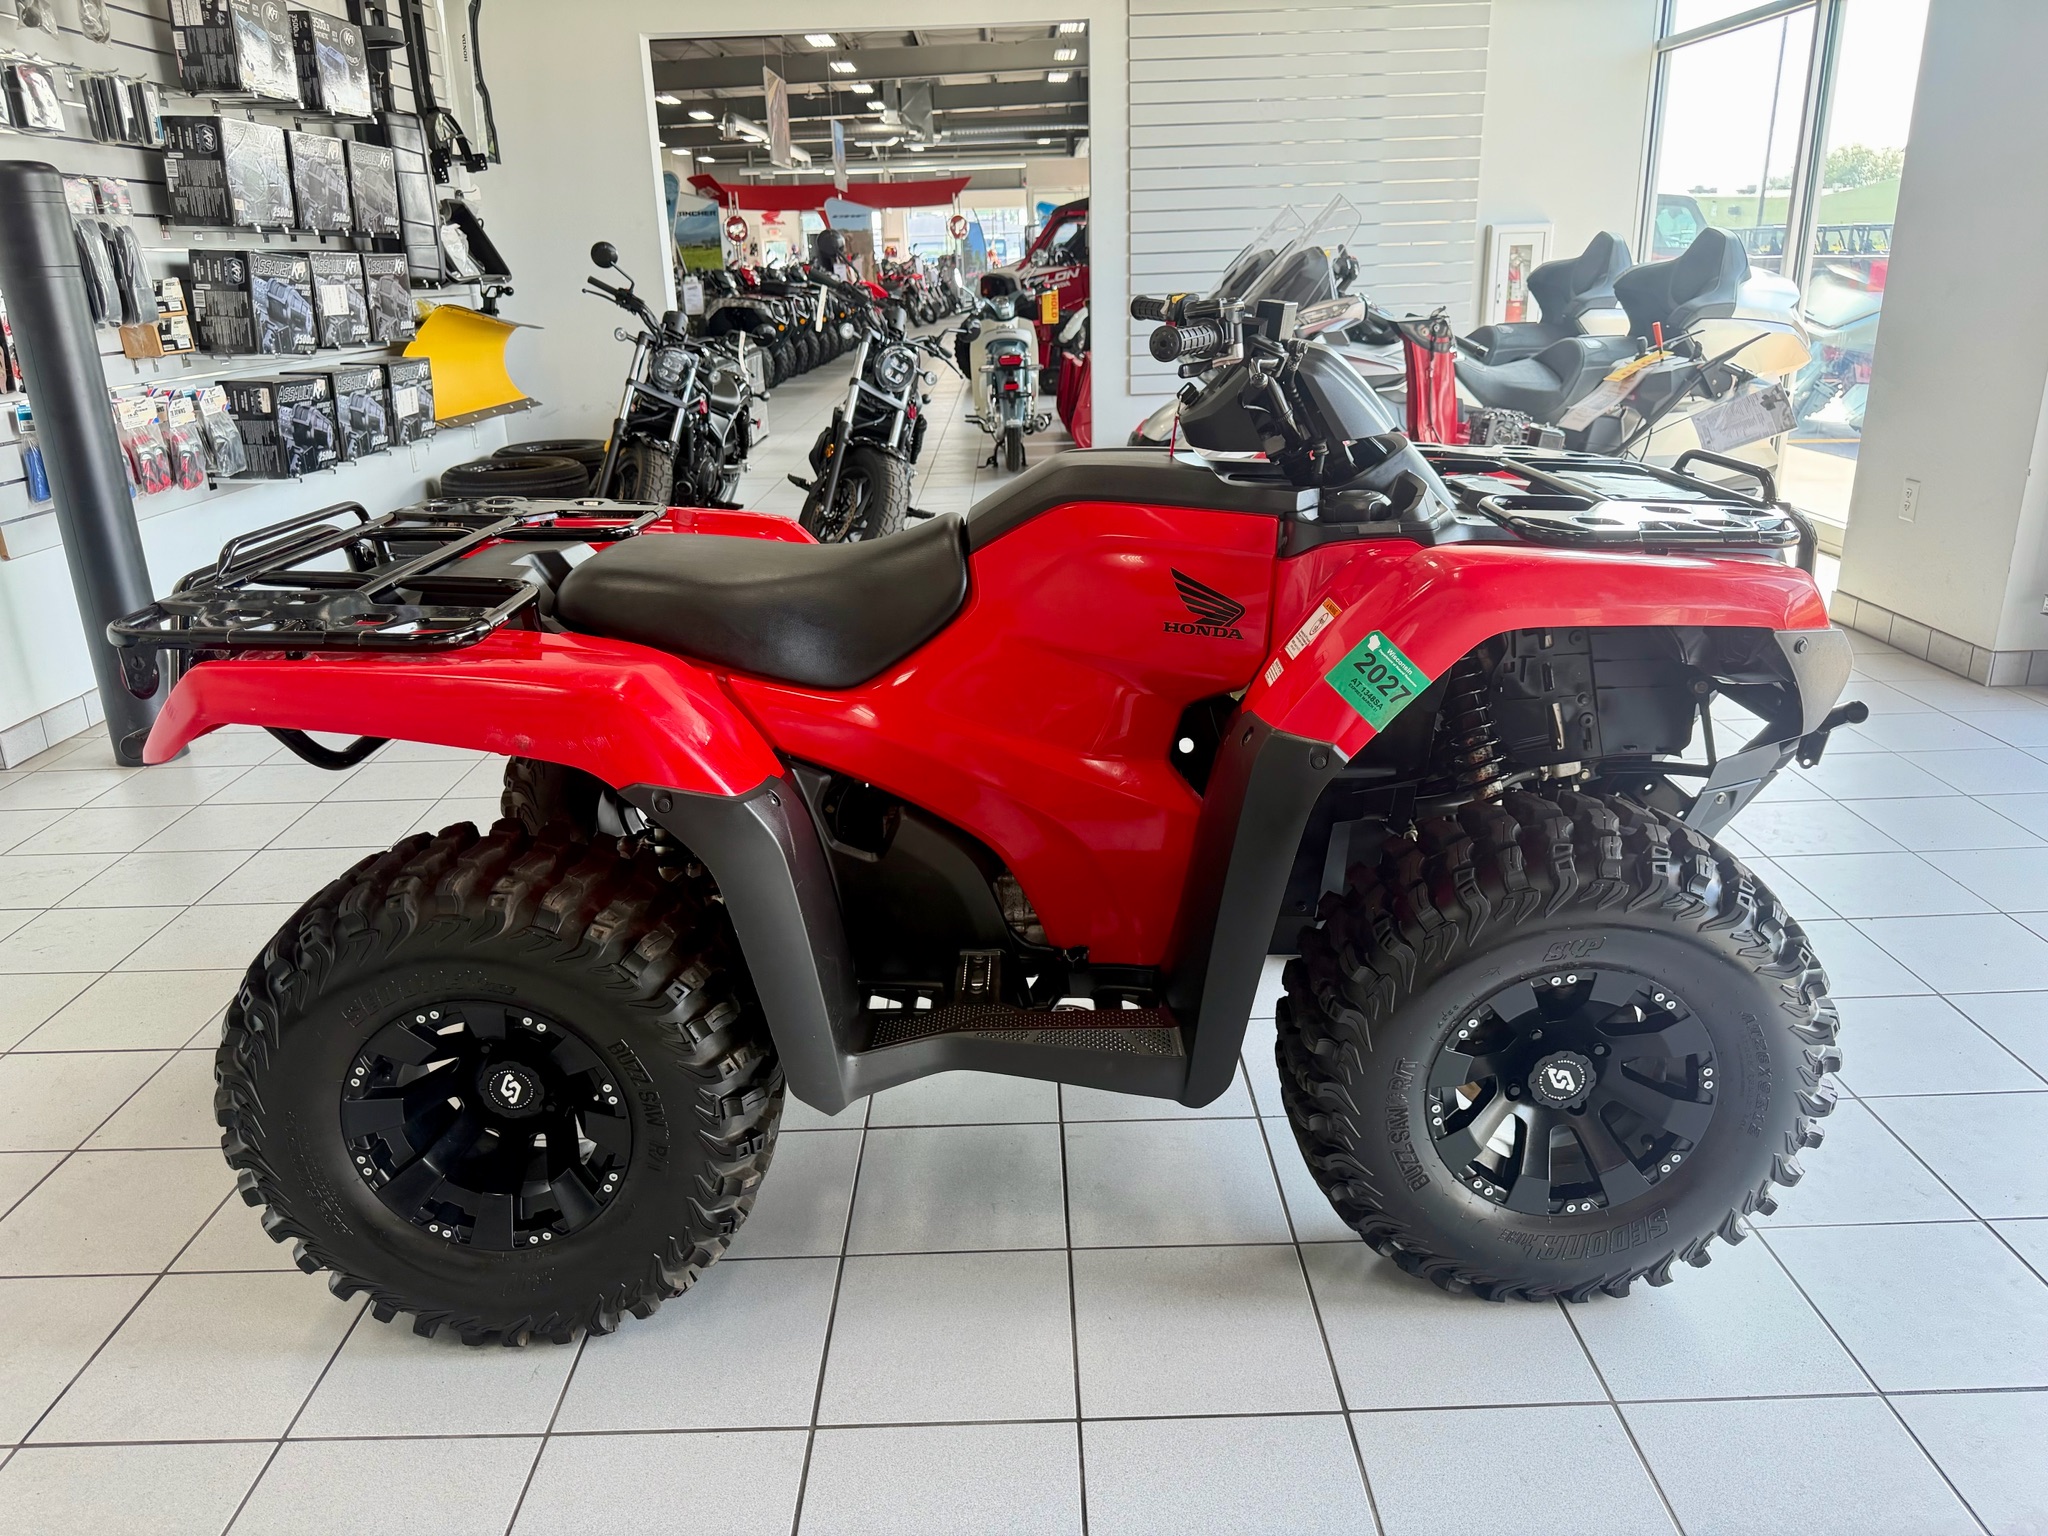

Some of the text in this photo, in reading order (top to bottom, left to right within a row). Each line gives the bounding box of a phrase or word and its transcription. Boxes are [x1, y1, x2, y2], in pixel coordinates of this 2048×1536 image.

[252, 256, 292, 278] ASSAULT
[313, 256, 346, 274] ASSAULT
[368, 258, 395, 274] ASSAULT
[336, 374, 368, 394] ASSAULT
[391, 365, 420, 383] ASSAULT
[277, 385, 314, 404] ASSAULT
[1164, 621, 1244, 640] HONDA
[1387, 648, 1413, 676] Wisconsin
[1353, 652, 1412, 703] 2027
[1348, 683, 1362, 697] EXPIRES
[1350, 678, 1384, 710] AT 1348SA
[606, 1039, 653, 1087] BUZZ
[638, 1091, 665, 1127] SAW
[1388, 1057, 1430, 1192] BUZZ SAW R/T
[1536, 1207, 1670, 1260] SEDONA
